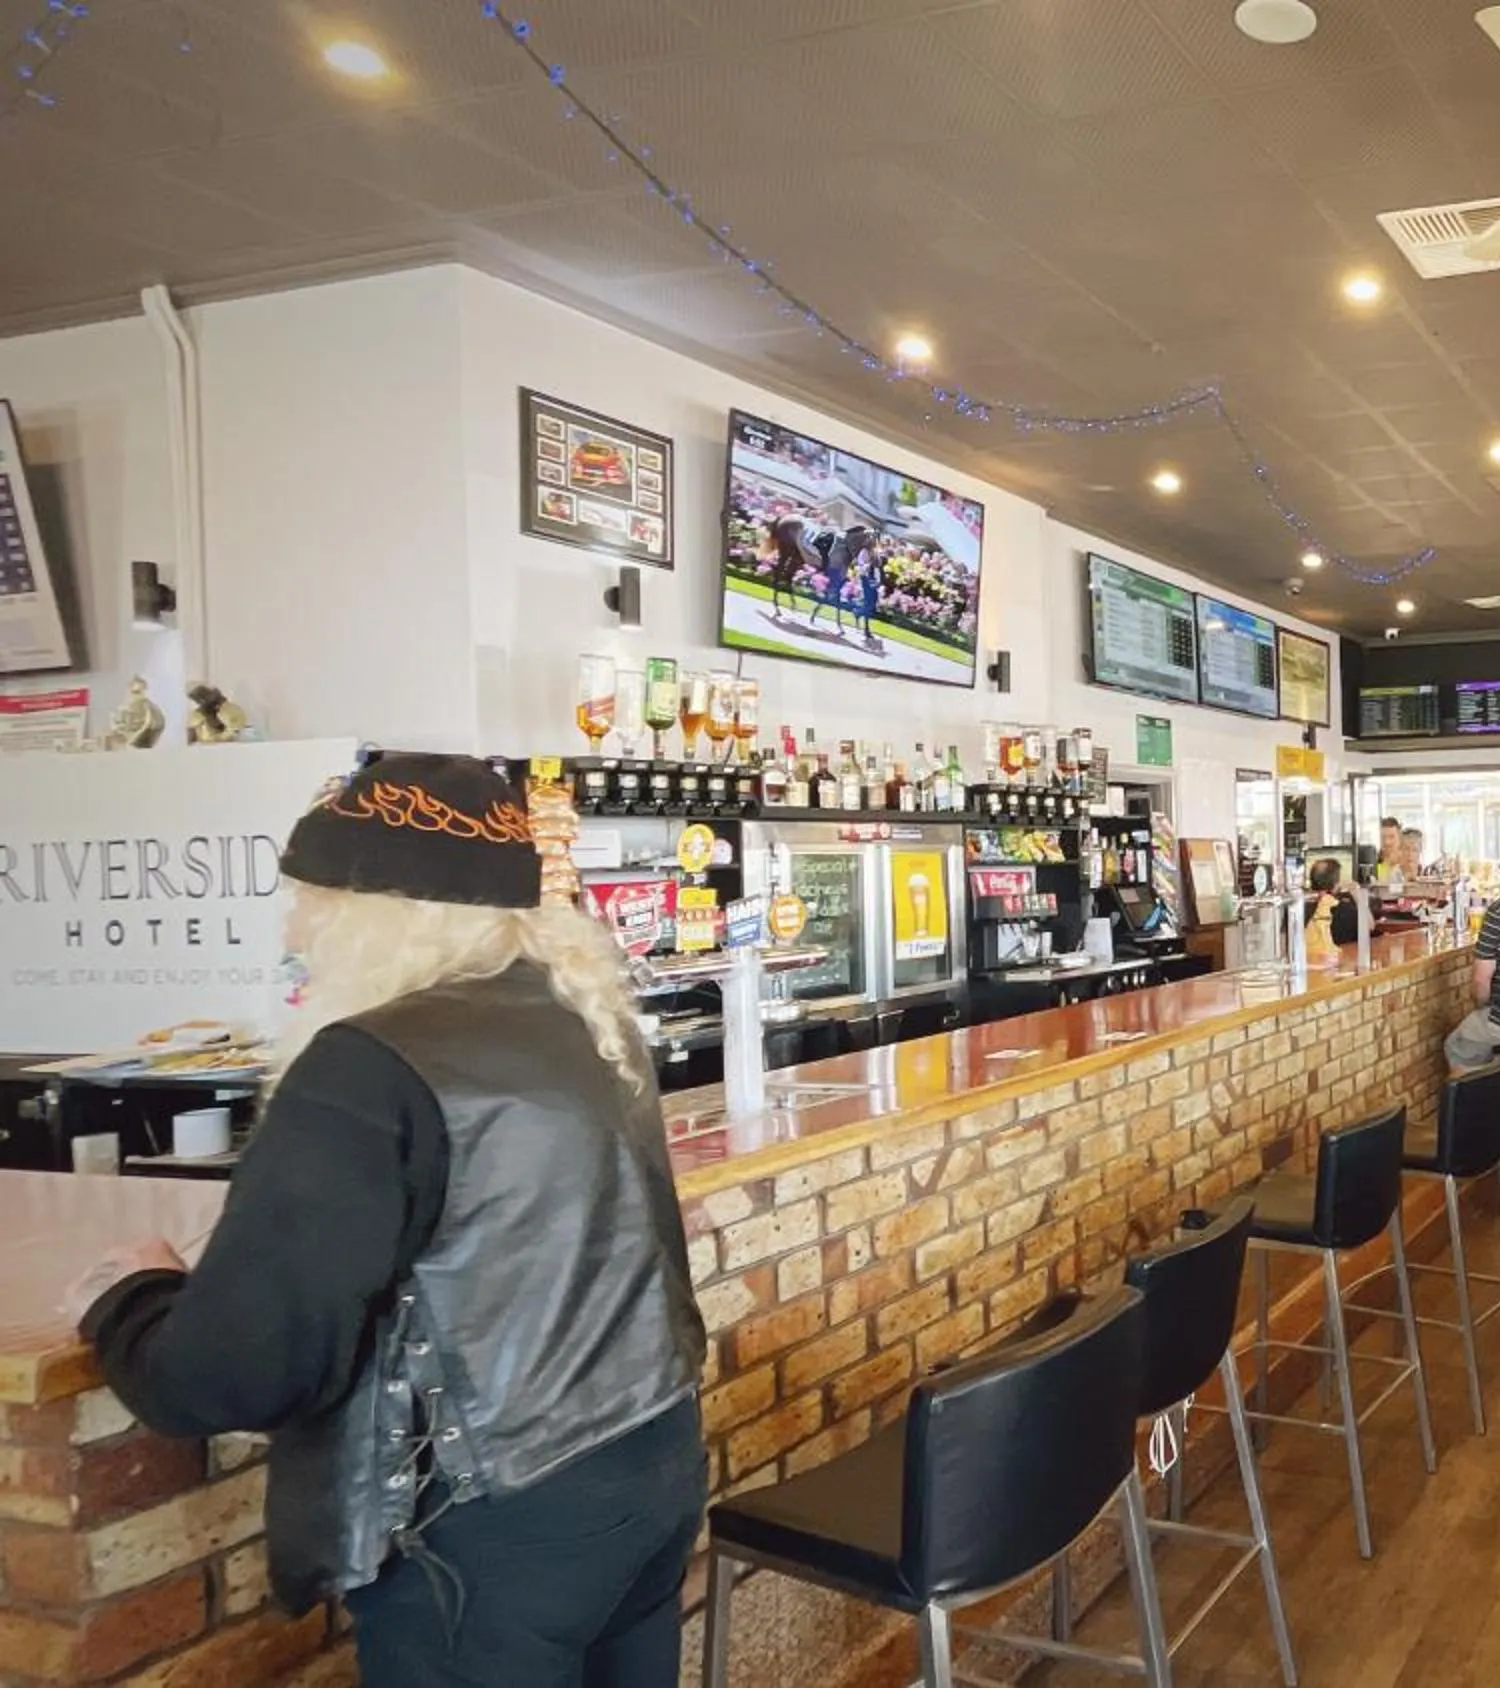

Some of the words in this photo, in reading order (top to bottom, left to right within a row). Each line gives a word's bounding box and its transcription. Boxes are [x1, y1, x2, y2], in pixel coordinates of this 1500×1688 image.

[0, 834, 280, 902] RIVERSID
[65, 917, 241, 946] HOTEL
[111, 968, 147, 985] AND
[217, 967, 263, 985] YOUR
